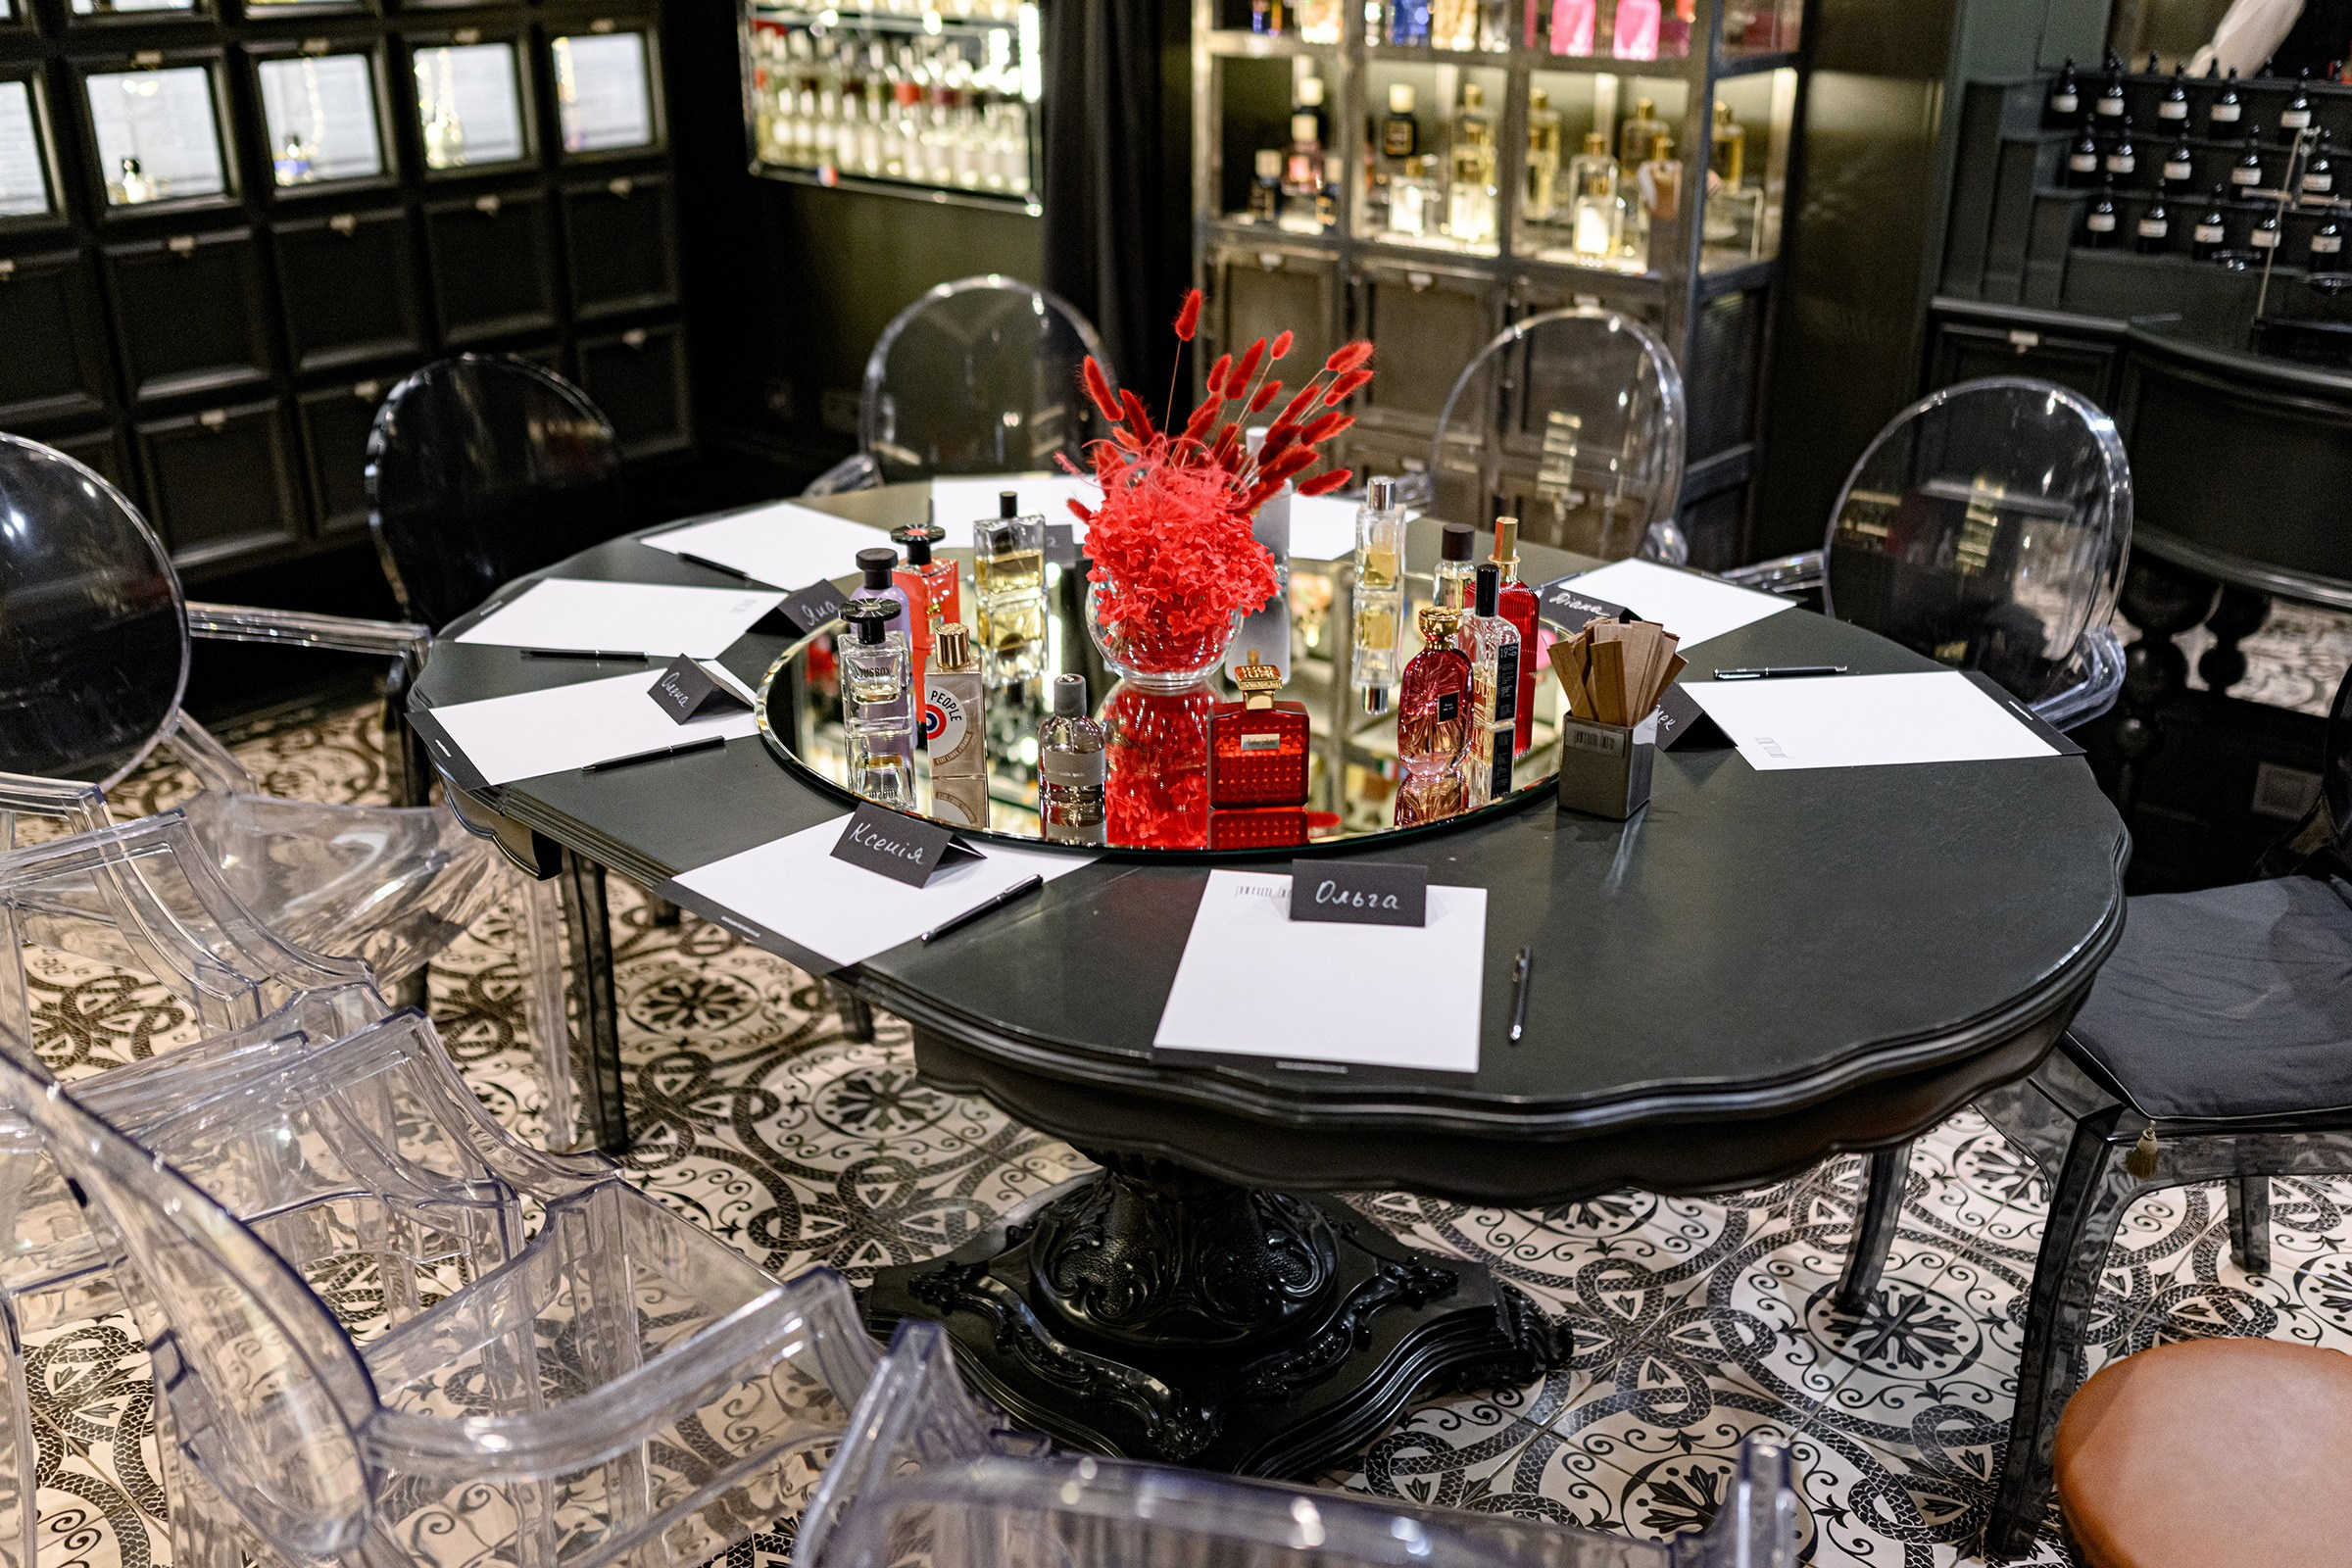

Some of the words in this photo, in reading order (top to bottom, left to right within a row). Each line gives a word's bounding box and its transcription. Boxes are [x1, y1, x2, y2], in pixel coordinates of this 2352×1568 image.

[930, 690, 962, 722] PEOPLE
[849, 822, 924, 865] Ксенія
[1315, 880, 1400, 910] Ольга
